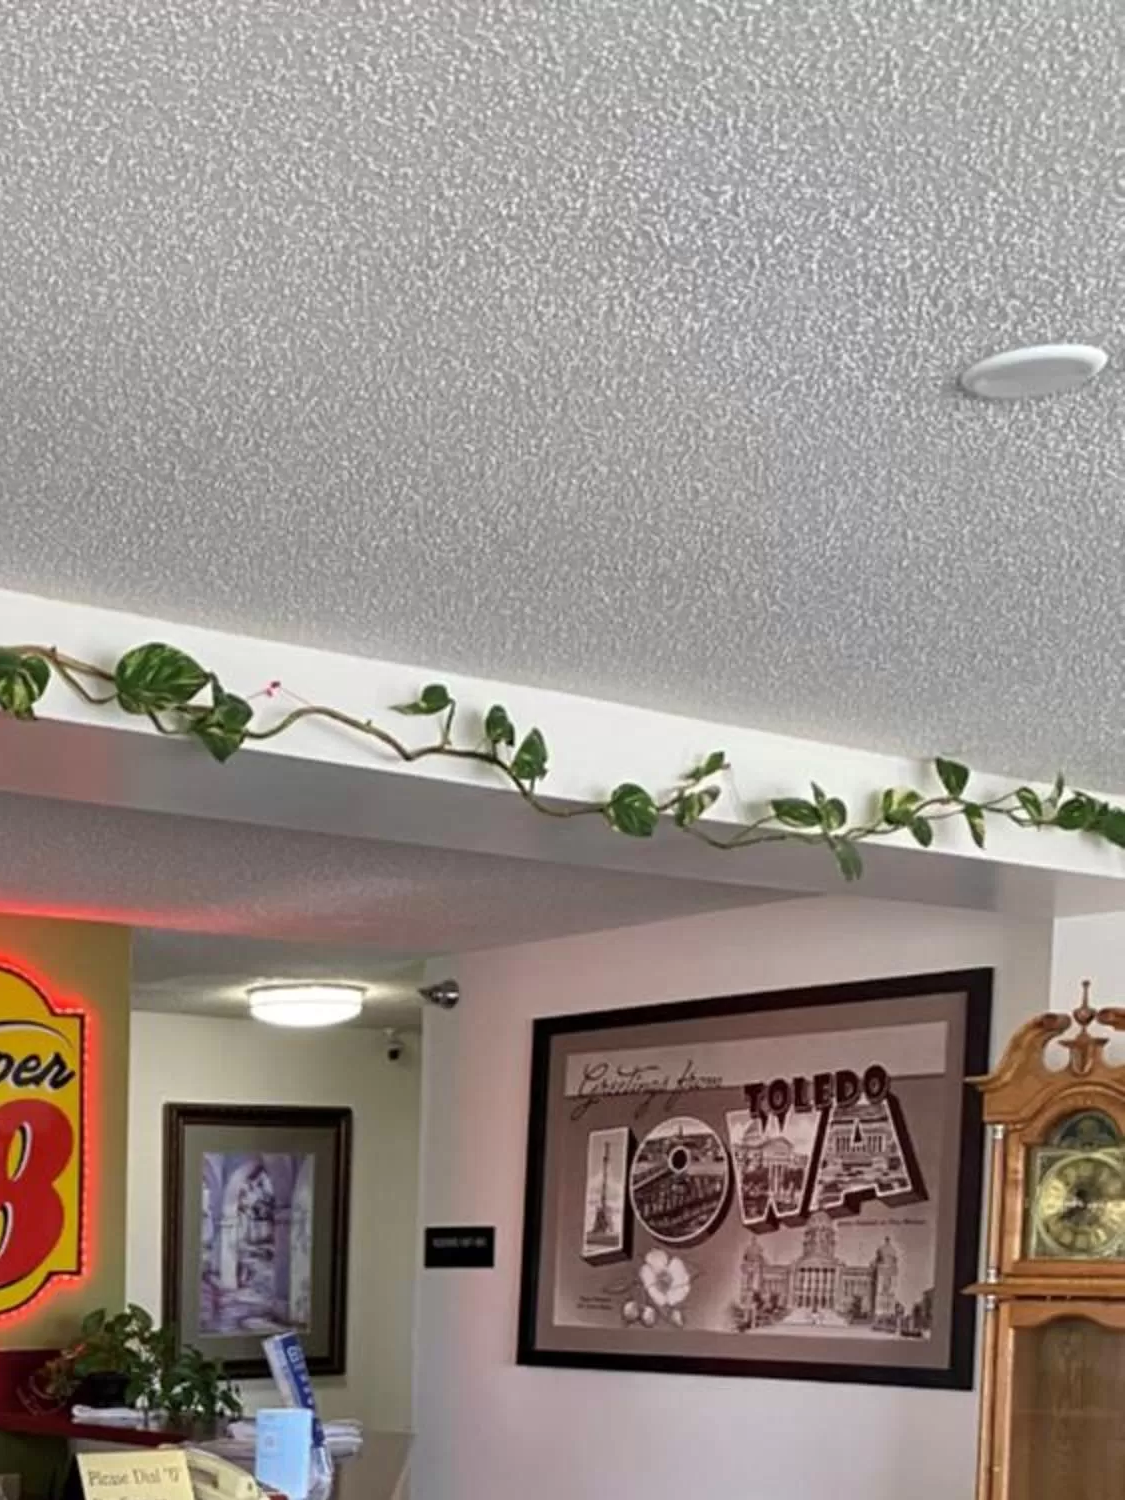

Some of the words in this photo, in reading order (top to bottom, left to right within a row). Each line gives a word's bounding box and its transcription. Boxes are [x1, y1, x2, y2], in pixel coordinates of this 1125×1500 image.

[743, 1063, 890, 1119] TOLEDO
[581, 1090, 929, 1267] IOWA
[88, 1469, 129, 1487] Please
[132, 1467, 161, 1485] Dial
